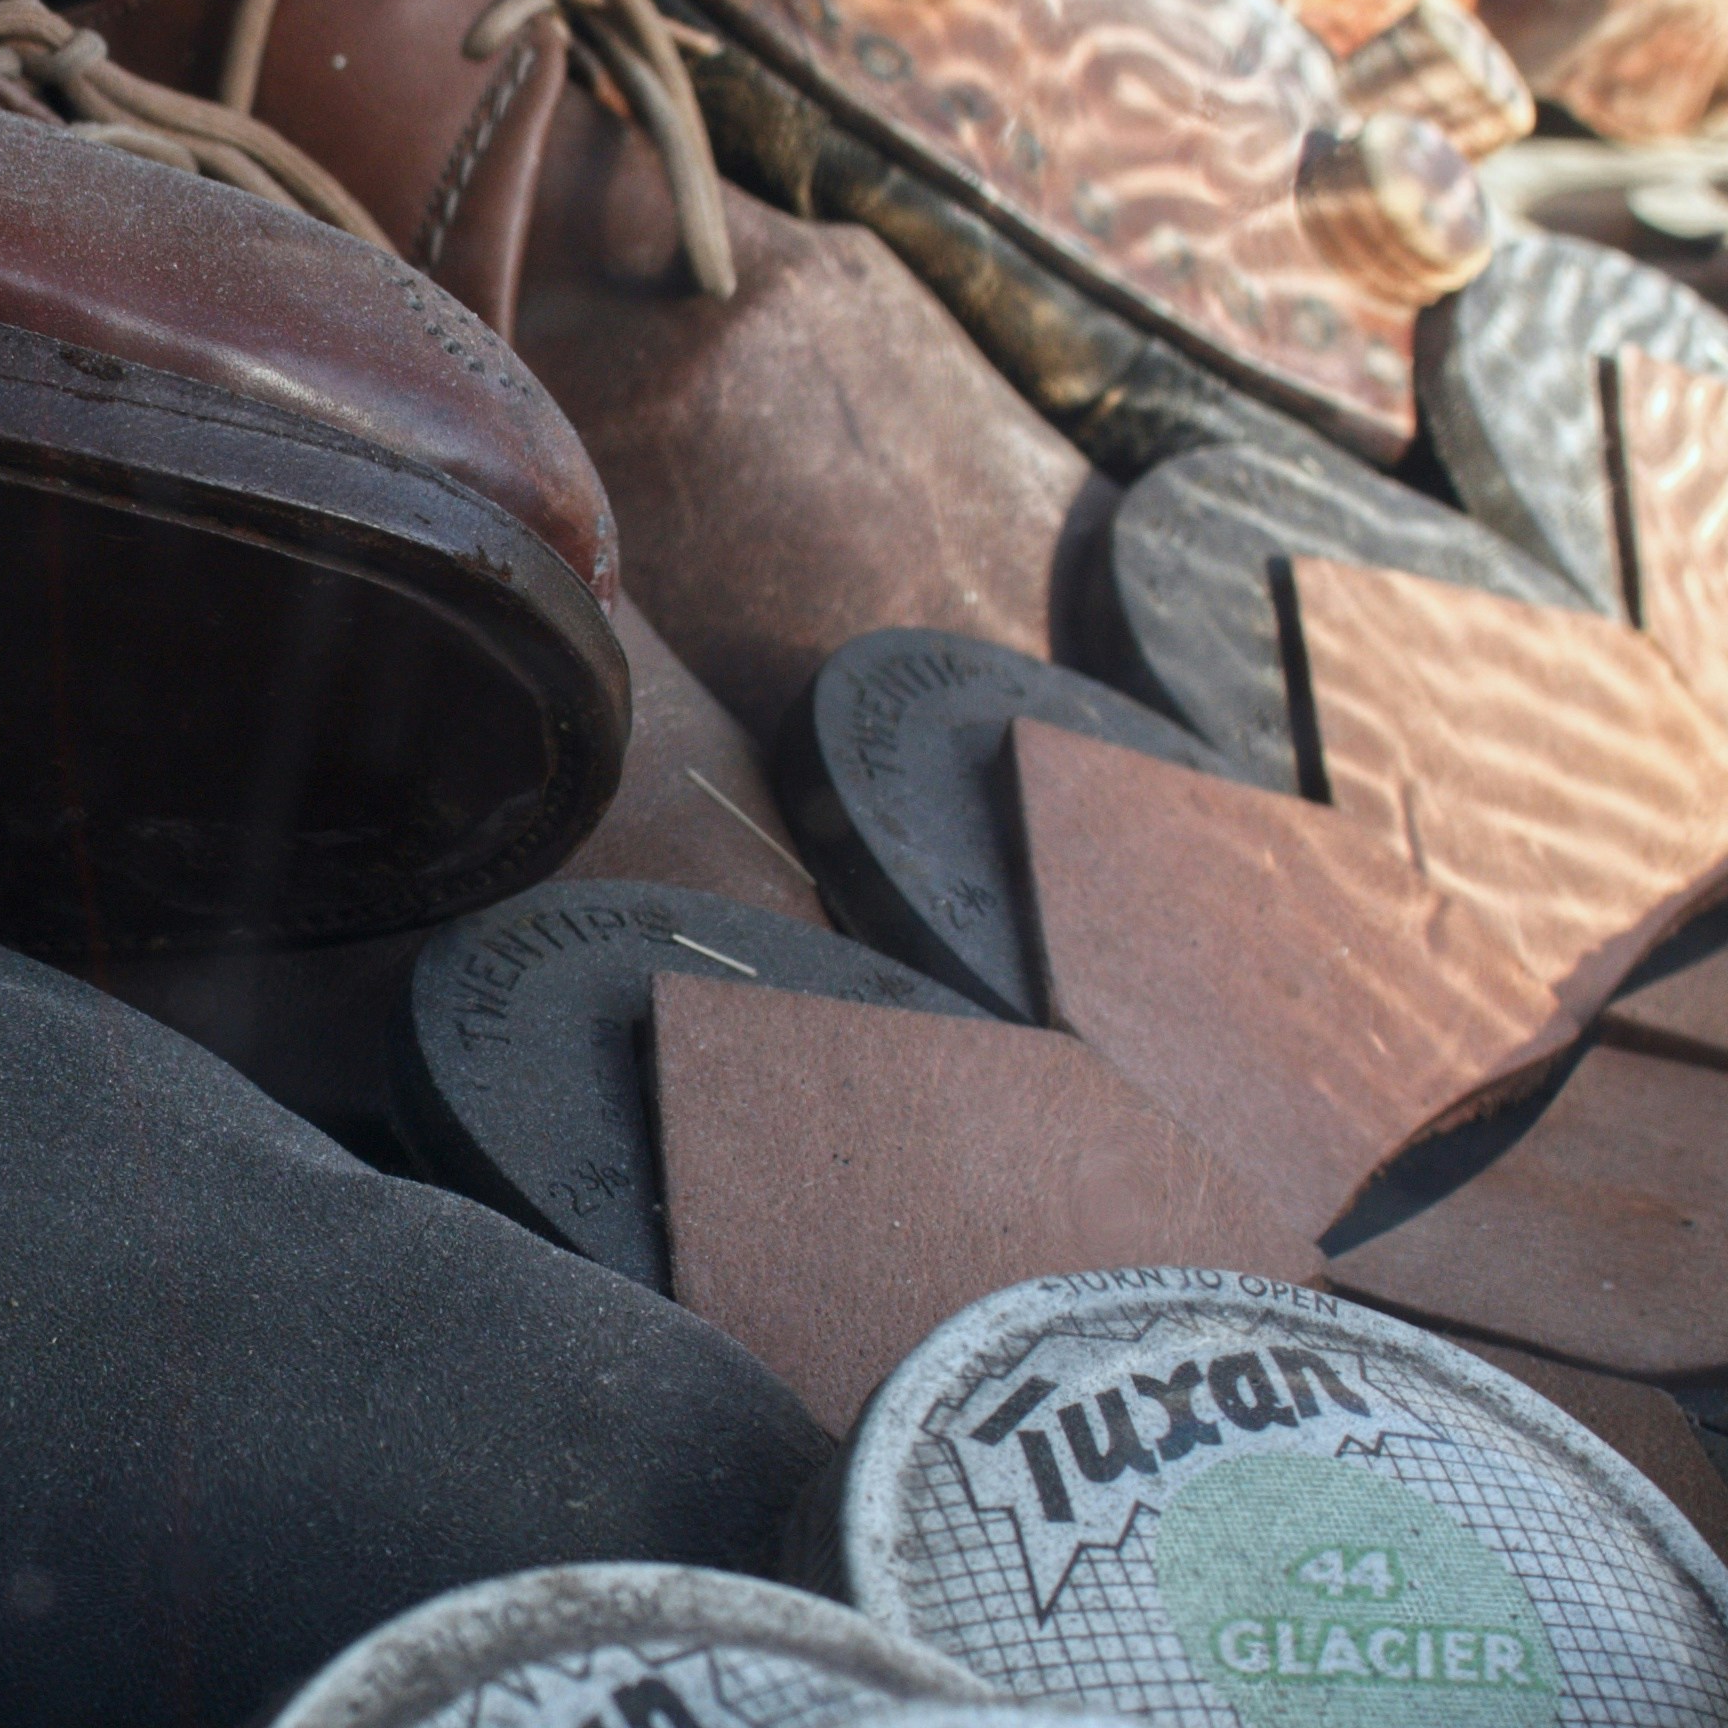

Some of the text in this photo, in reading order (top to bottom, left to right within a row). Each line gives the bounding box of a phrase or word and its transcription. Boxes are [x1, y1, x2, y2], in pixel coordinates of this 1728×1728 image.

[1237, 1273, 1340, 1319] OPEN
[969, 1344, 1371, 1523] Tuxan
[1297, 1547, 1395, 1597] 44
[1217, 1618, 1526, 1678] GLACIER
